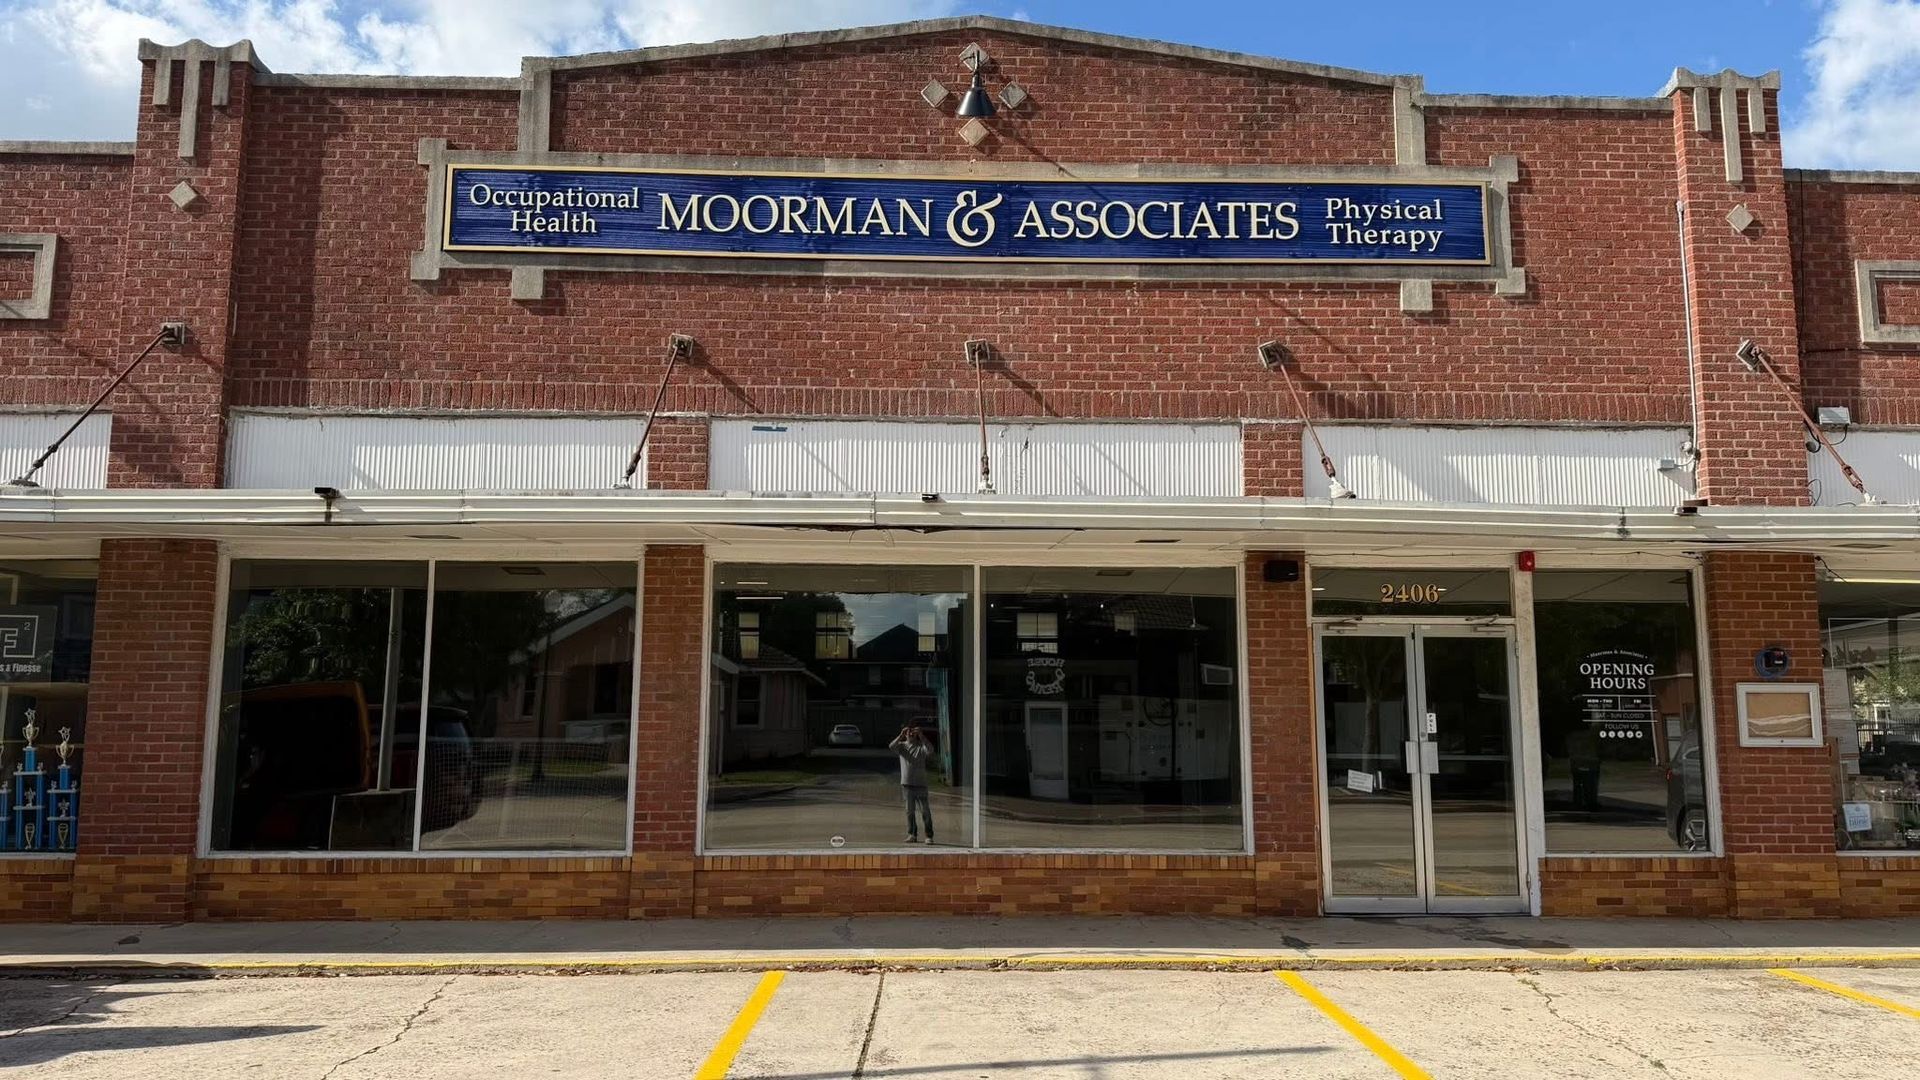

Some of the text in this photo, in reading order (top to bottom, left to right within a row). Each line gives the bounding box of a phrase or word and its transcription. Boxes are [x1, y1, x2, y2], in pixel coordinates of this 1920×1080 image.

[469, 182, 640, 210] Occupational
[510, 209, 598, 234] Health
[656, 189, 1300, 248] MOORMAN & ASSOCIATES
[1324, 197, 1444, 224] Physical
[1325, 223, 1444, 252] Therapy
[1380, 584, 1439, 603] 2406
[12, 663, 41, 673] Finesse
[1580, 663, 1654, 675] OPENING
[1590, 677, 1646, 689] HOURS
